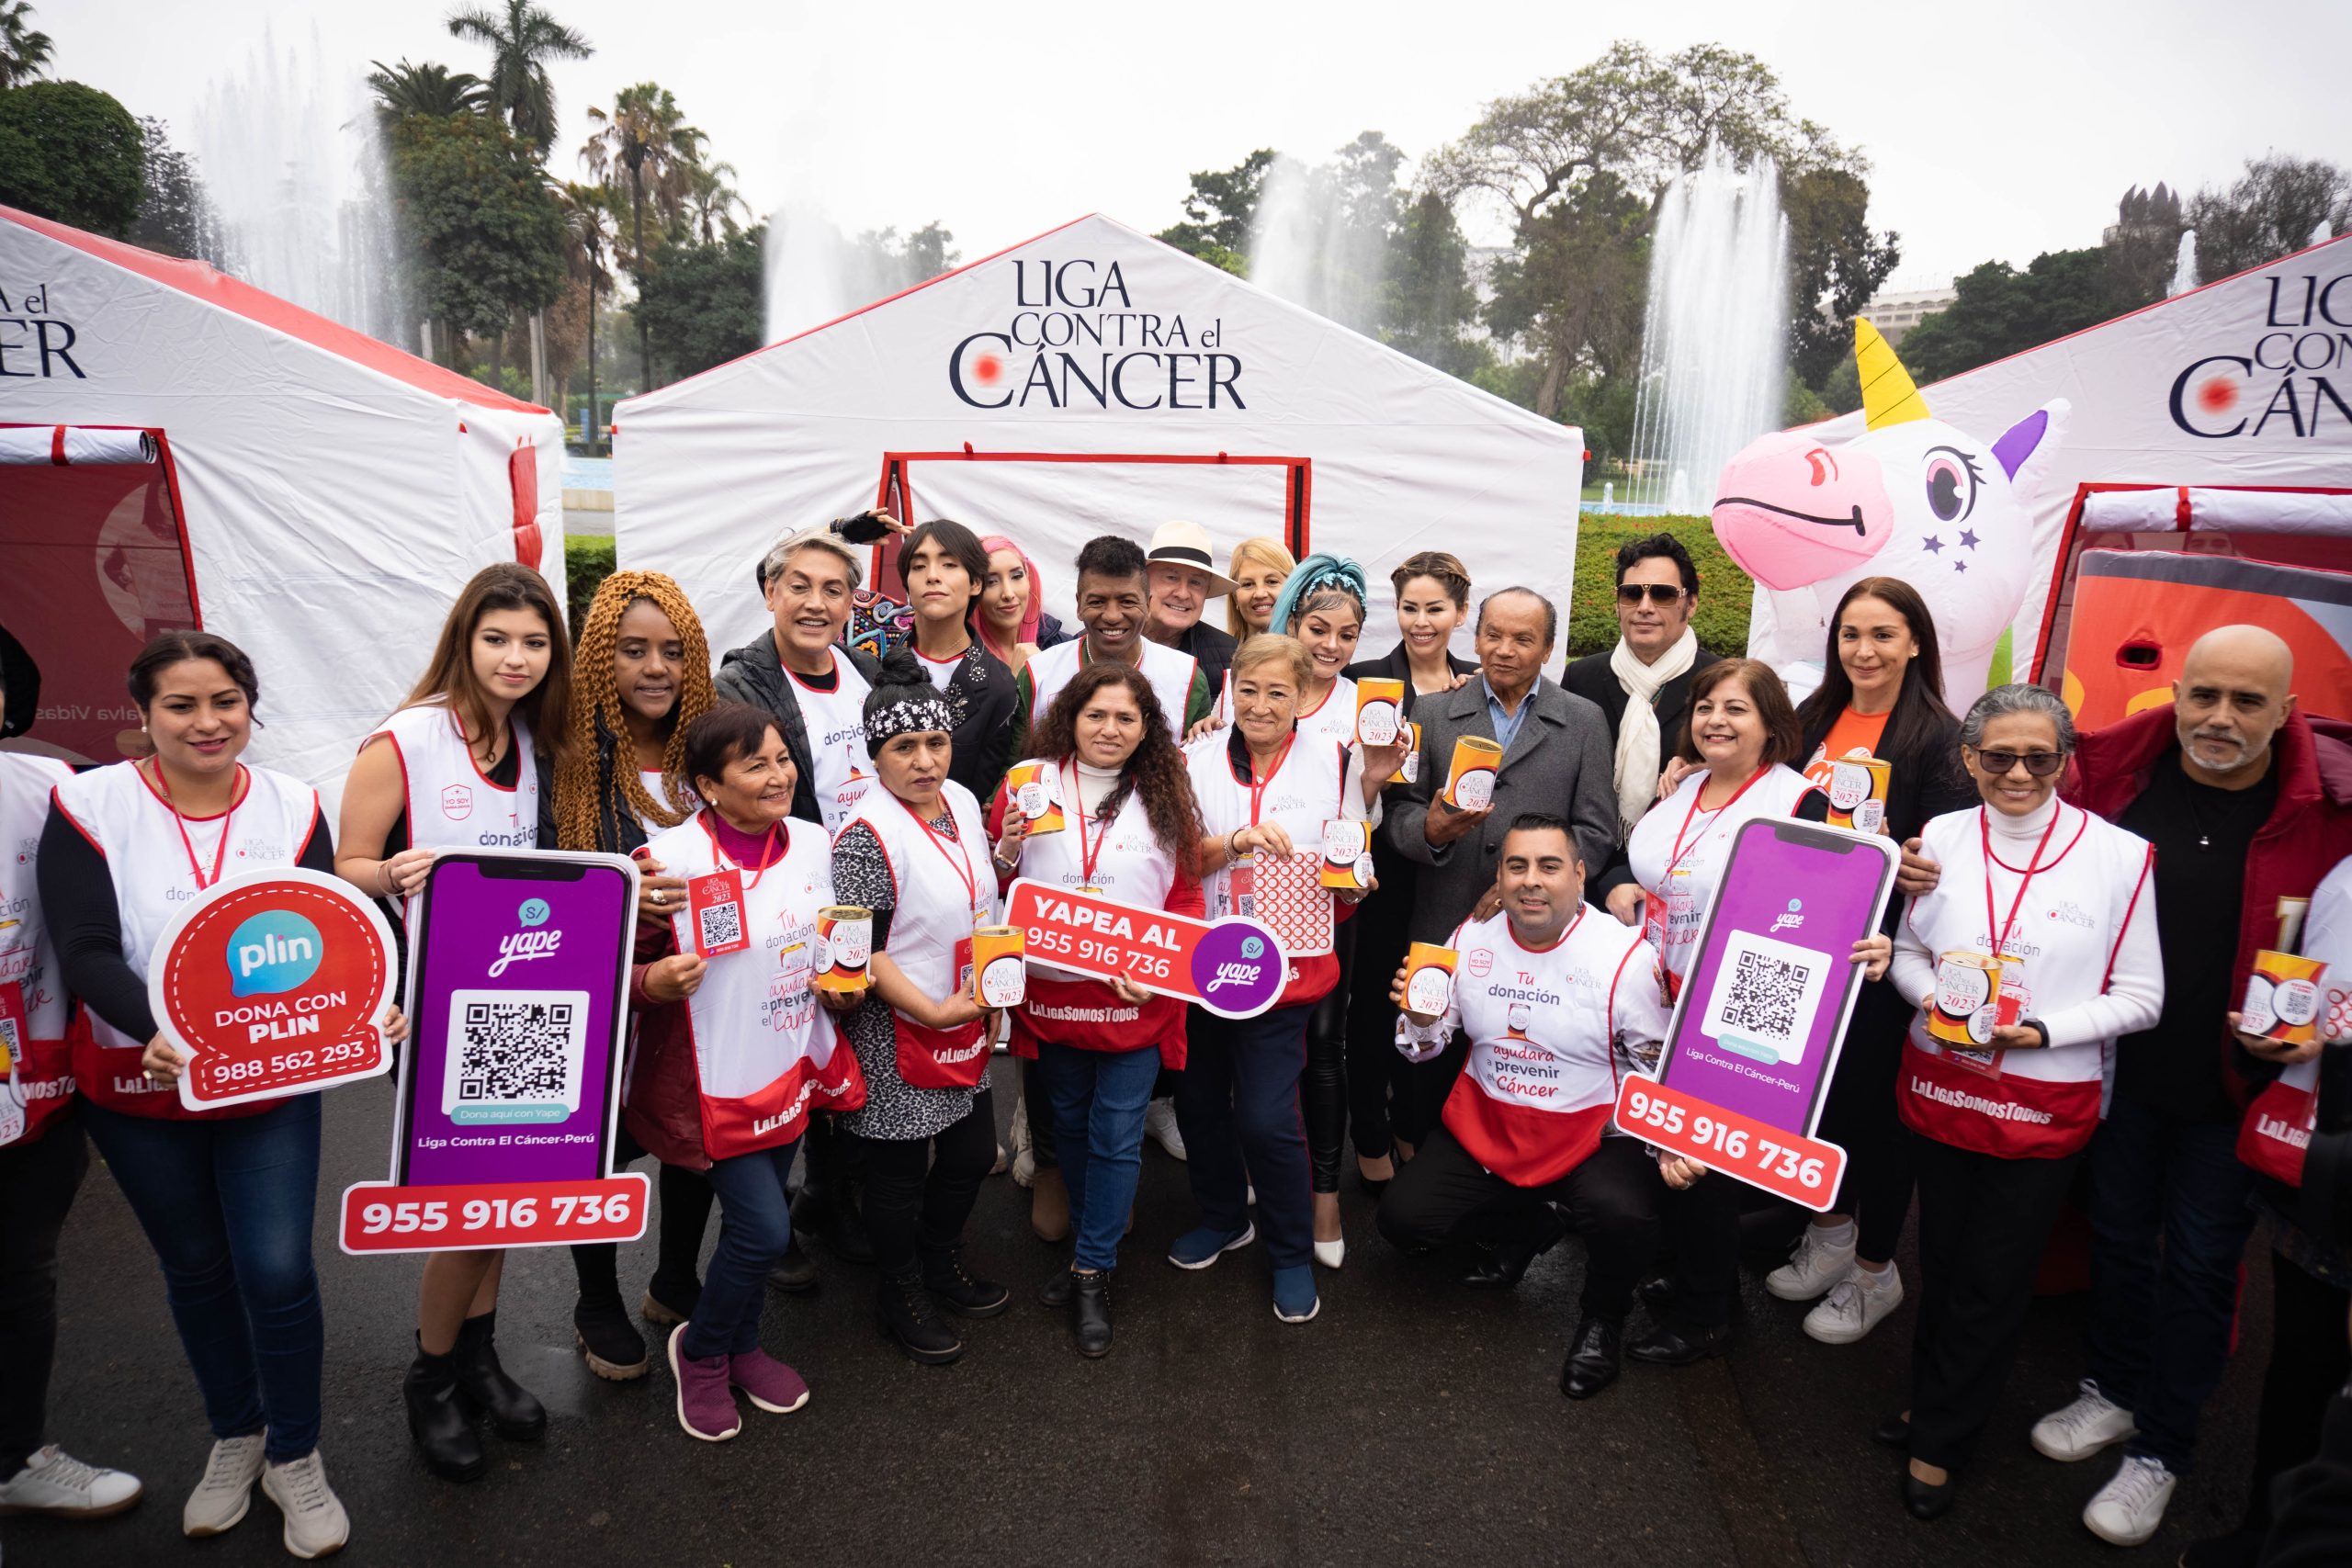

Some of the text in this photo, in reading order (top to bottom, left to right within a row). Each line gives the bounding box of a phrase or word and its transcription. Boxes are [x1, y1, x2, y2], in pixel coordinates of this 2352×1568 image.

[1012, 260, 1131, 308] LIGA
[25, 283, 48, 313] el
[1012, 311, 1221, 348] CONTRA el
[949, 333, 1246, 410] CÁNCER
[1369, 731, 1392, 740] 2023
[1834, 791, 1860, 804] 2023
[712, 893, 730, 904] 2023
[777, 908, 797, 931] Tu
[1034, 895, 1182, 952] YAPEA AL
[1770, 913, 1804, 932] yape
[766, 922, 815, 949] donación
[239, 933, 312, 976] plin
[488, 930, 562, 977] yape
[1027, 927, 1170, 977] 955 916 736
[1206, 962, 1261, 993] yape
[1517, 971, 1535, 986] Tu
[998, 991, 1022, 1003] 2023
[1419, 998, 1443, 1012] 2023
[1488, 984, 1560, 1006] donación
[1944, 995, 1975, 1010] 2023
[215, 990, 346, 1028] DONA CON
[763, 1014, 772, 1027] el
[248, 1014, 320, 1044] PLIN
[213, 1041, 365, 1084] 988 562 293
[1495, 1060, 1560, 1079] prevenir
[1686, 1047, 1800, 1093] Liga Contra El Cáncer-Perú
[1497, 1076, 1559, 1098] Cáncer
[460, 1108, 560, 1120] Dona aquí con Yape
[418, 1132, 595, 1149] Liga Contra El Cáncer-Perú
[1628, 1092, 1825, 1189] 955 916 736
[362, 1193, 630, 1235] 955 916 736
